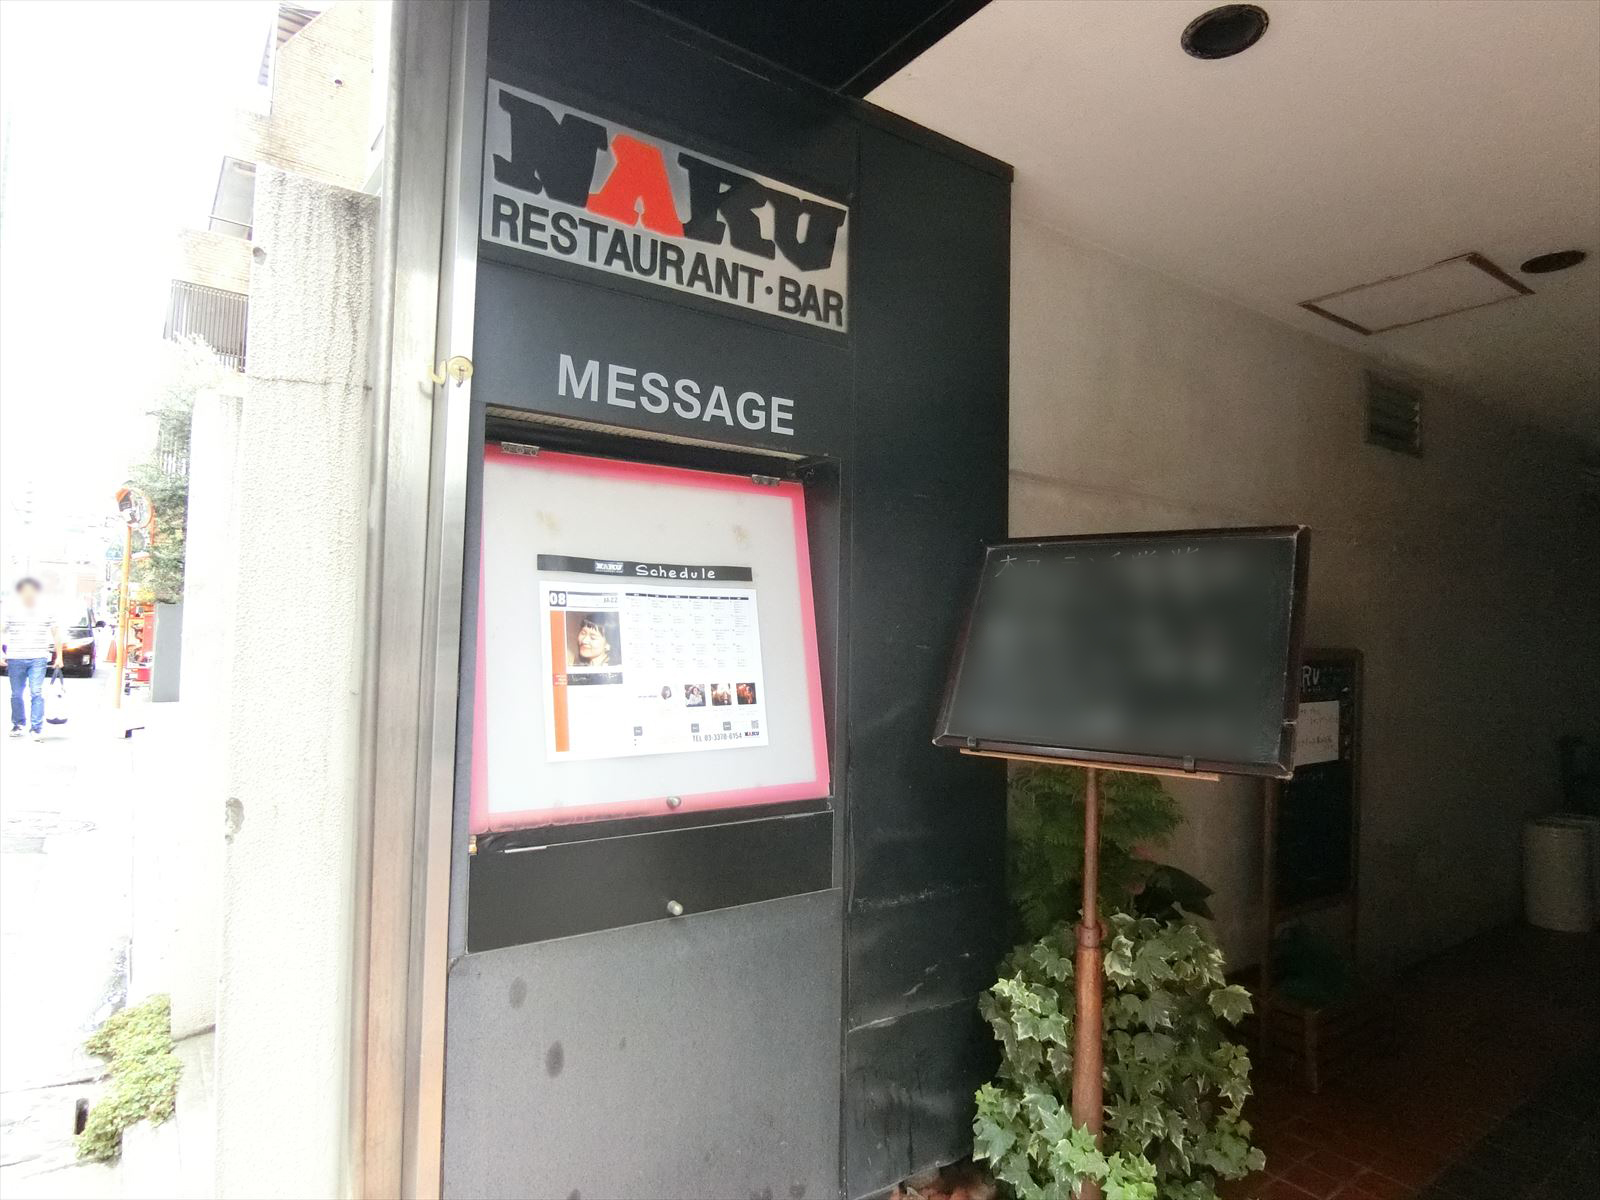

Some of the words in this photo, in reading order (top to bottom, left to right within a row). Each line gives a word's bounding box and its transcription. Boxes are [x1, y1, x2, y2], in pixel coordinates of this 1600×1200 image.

[493, 88, 847, 272] NARU
[558, 353, 795, 436] MESSAGE
[635, 564, 716, 579] Schedule
[550, 592, 566, 605] 08
